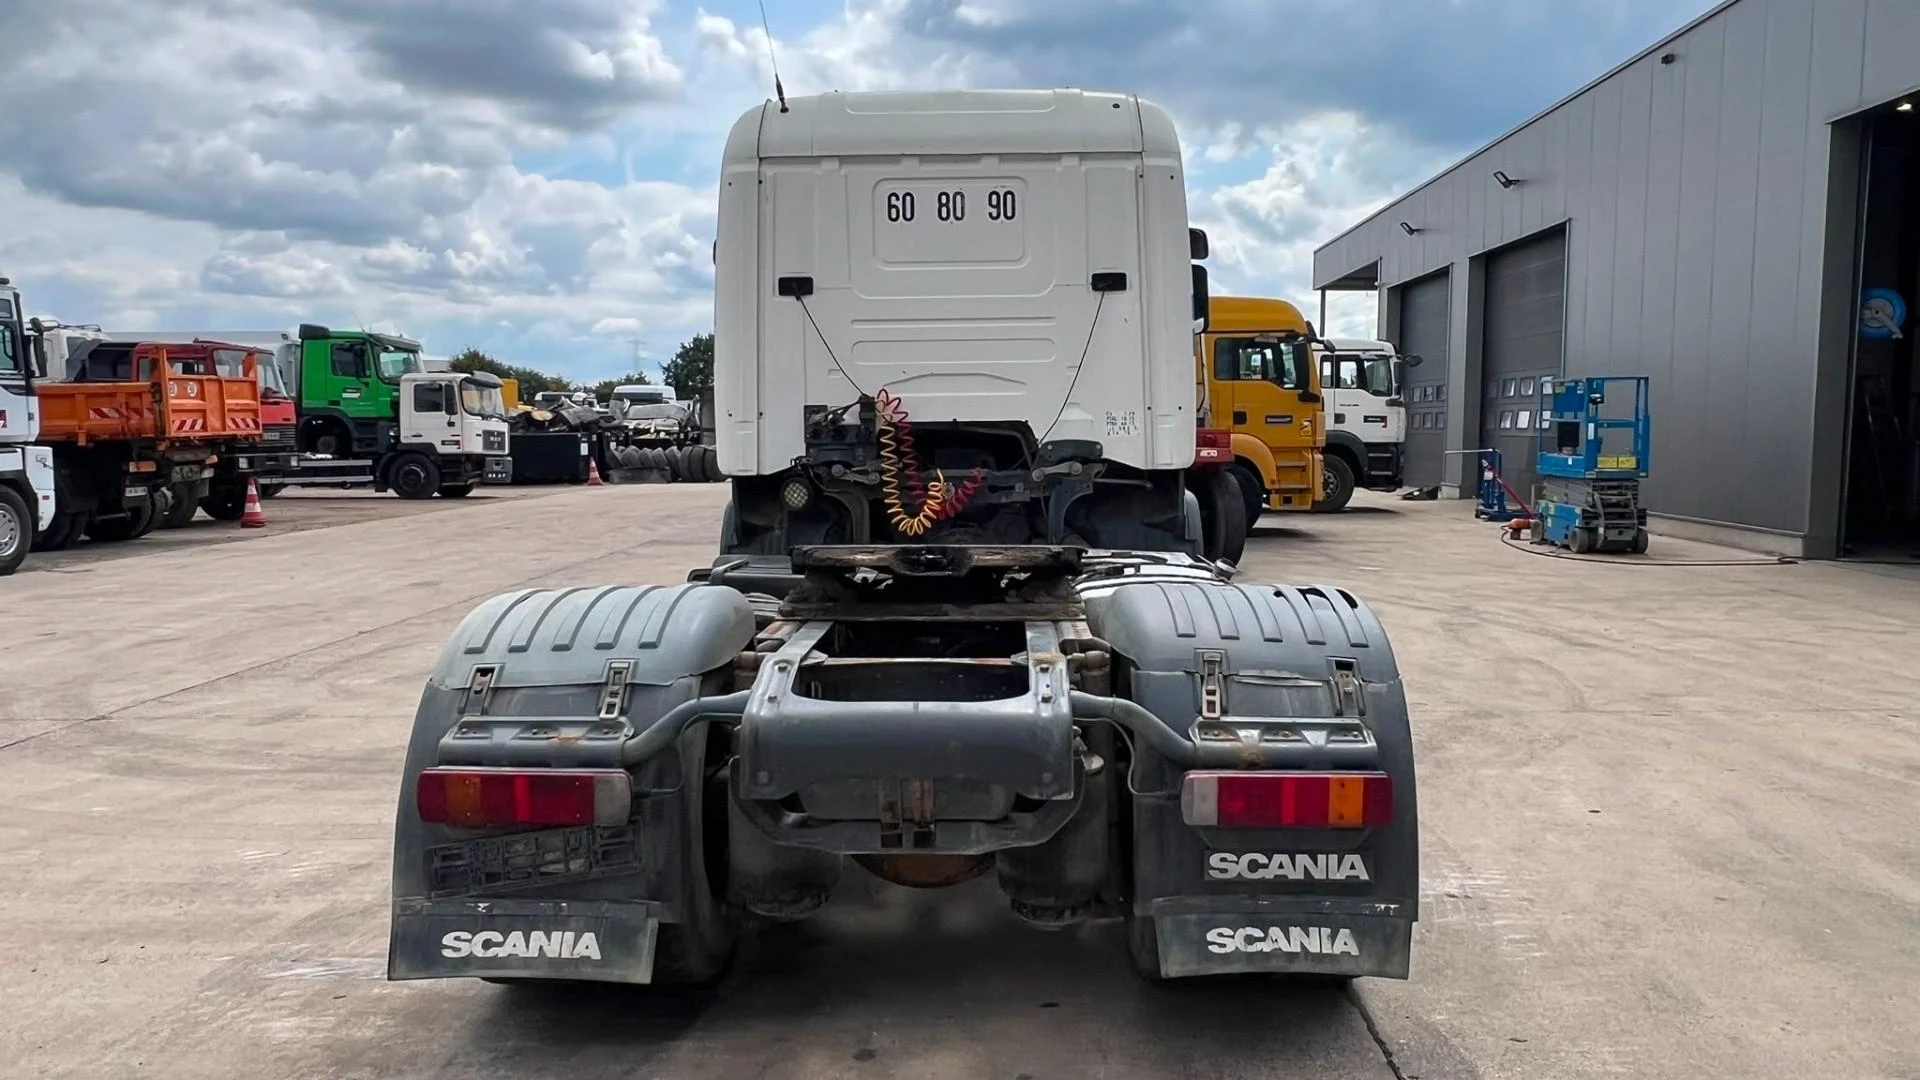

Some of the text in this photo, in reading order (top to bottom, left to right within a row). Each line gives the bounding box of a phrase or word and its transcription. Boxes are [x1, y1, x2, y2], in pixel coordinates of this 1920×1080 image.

[887, 190, 1016, 222] 60 80 90
[1208, 852, 1369, 881] SCANIA
[441, 930, 602, 960] SCANIA
[1206, 926, 1360, 956] SCANIA
